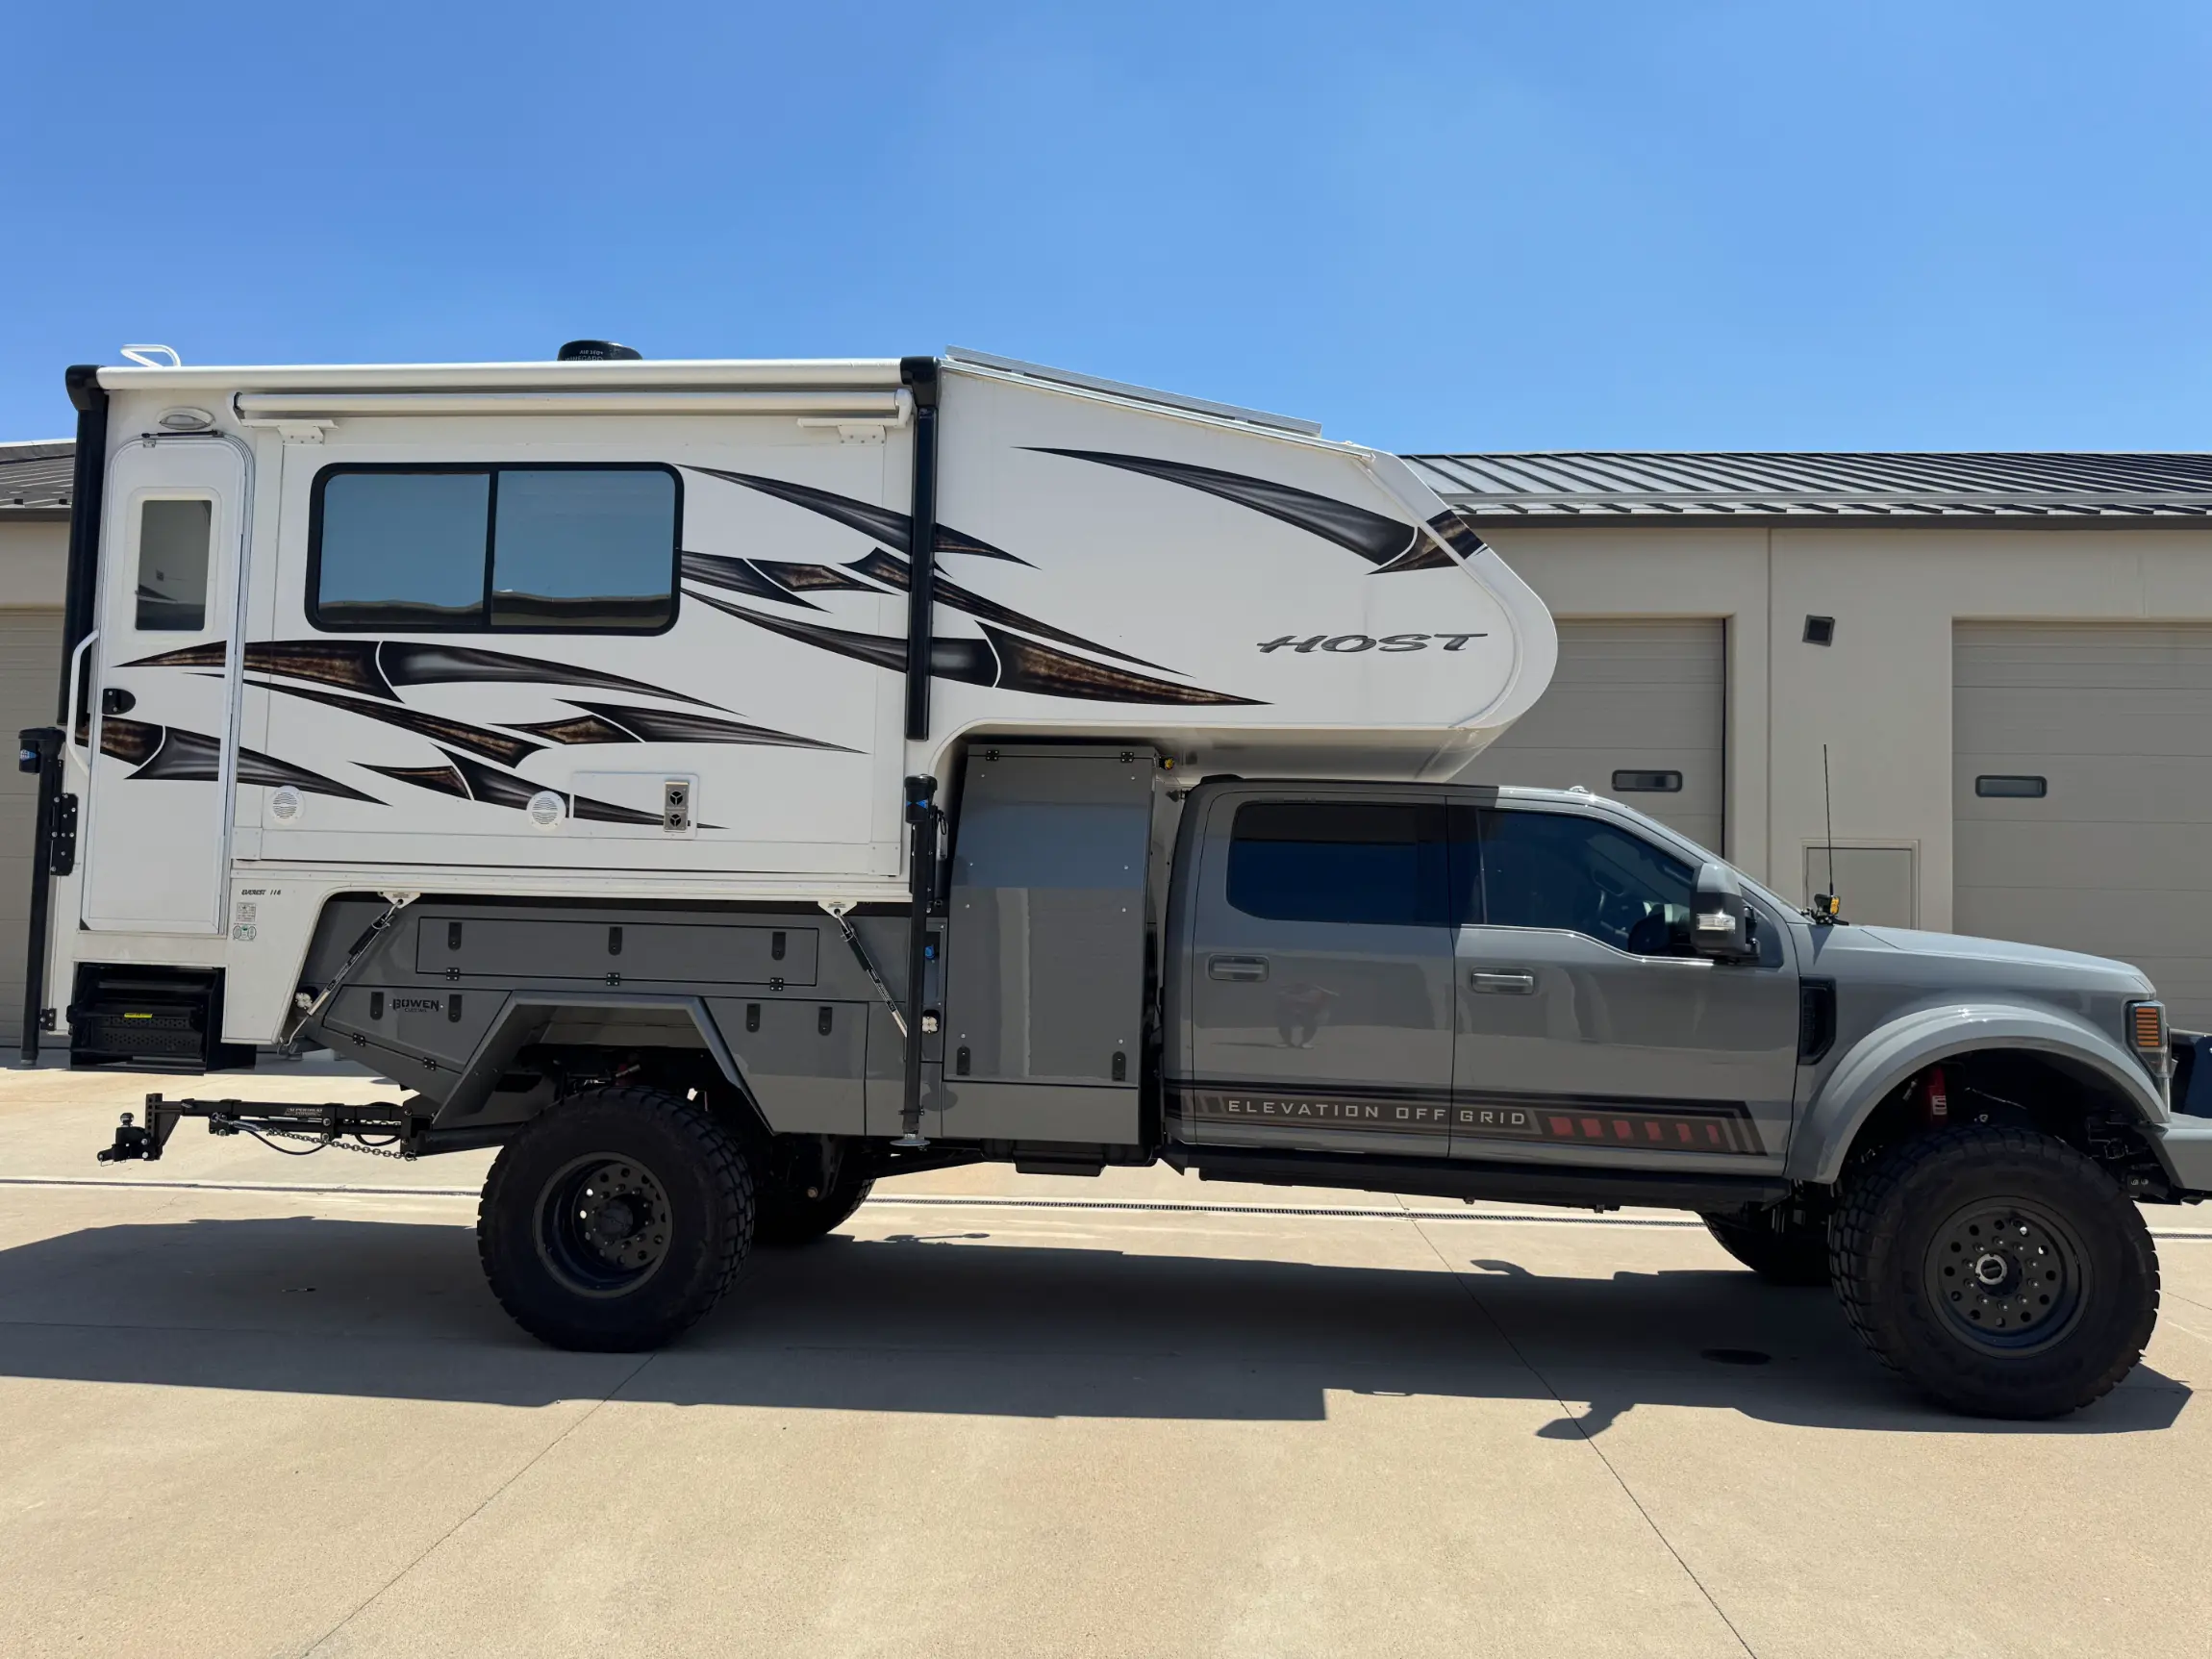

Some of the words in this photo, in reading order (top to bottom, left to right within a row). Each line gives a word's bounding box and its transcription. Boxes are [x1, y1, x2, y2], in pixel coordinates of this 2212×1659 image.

[1256, 633, 1489, 654] HOST
[392, 998, 440, 1012] BOWEN
[1228, 1099, 1379, 1119] ELEVATION
[1395, 1107, 1446, 1121] OFF
[1460, 1110, 1525, 1125] GRID
